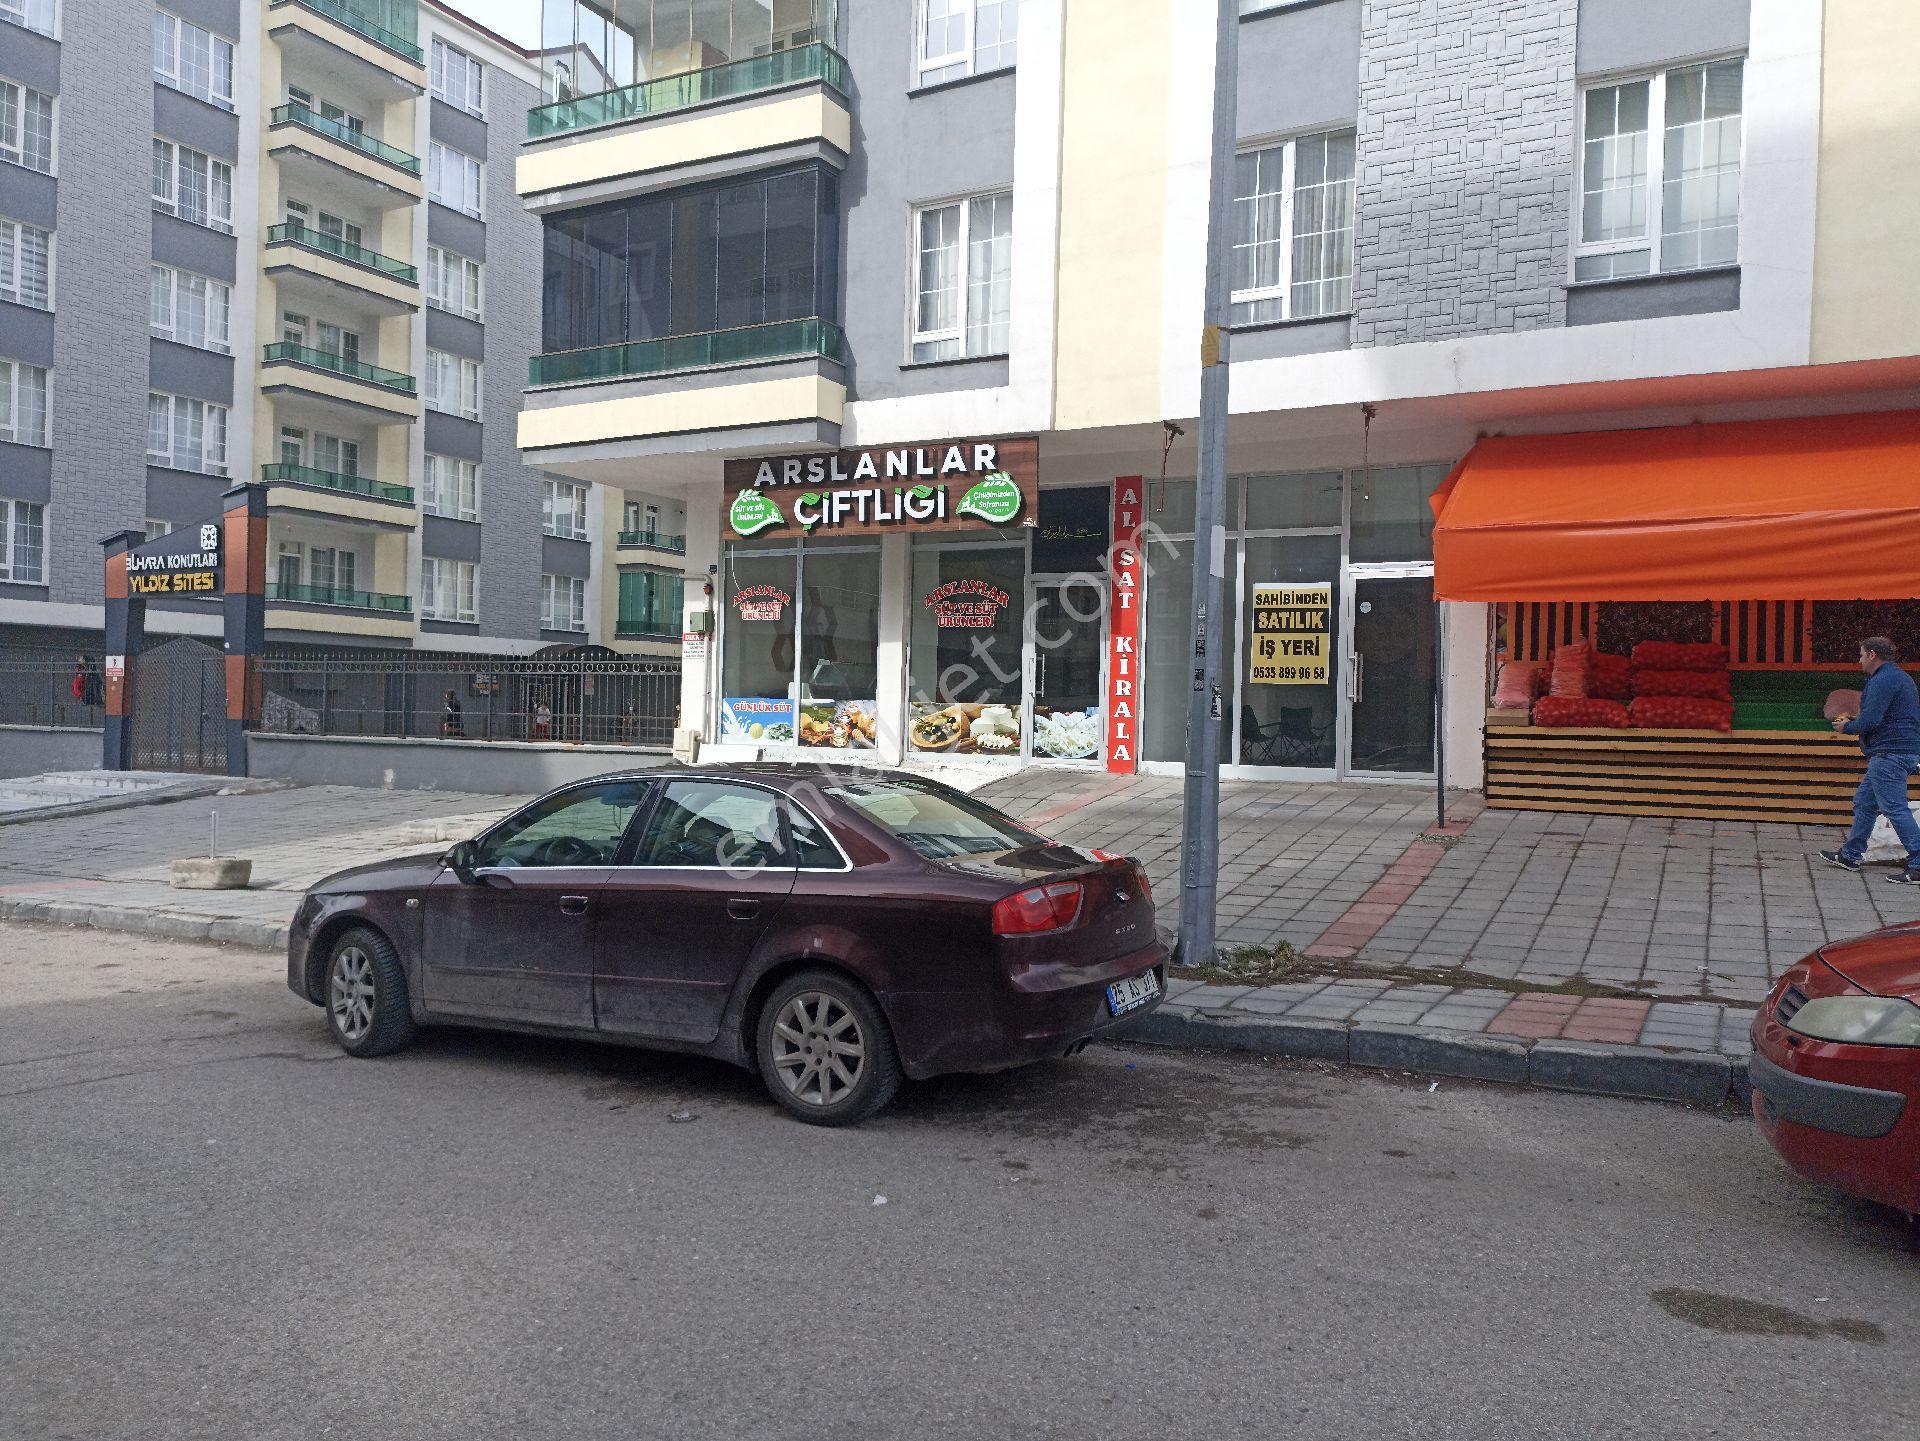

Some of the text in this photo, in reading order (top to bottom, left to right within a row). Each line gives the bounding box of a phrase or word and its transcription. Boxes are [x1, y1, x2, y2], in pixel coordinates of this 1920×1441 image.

[754, 444, 996, 487] ARSLANLAR
[735, 502, 766, 513] SÜT VE SÜT
[736, 511, 764, 521] ÜRÜNLERİ
[794, 485, 945, 531] ÇİFTLİĞİ
[1120, 488, 1138, 529] AL
[129, 574, 171, 593] YILDIZ
[1118, 549, 1136, 609] SAT
[732, 584, 791, 607] ARSLANLAR
[925, 579, 1010, 610] ARSLANLAR
[1255, 590, 1328, 606] SAHİBİNDEN
[766, 599, 783, 612] SÜT
[935, 599, 999, 615] SÜT VE SÜT
[937, 612, 995, 627] ÜRÜNLERİ
[1258, 611, 1324, 629] SATILIK
[1259, 635, 1320, 660] İŞ YERİ
[733, 701, 793, 713] GÜNLÜK SÜT
[1113, 636, 1134, 760] KİRALA
